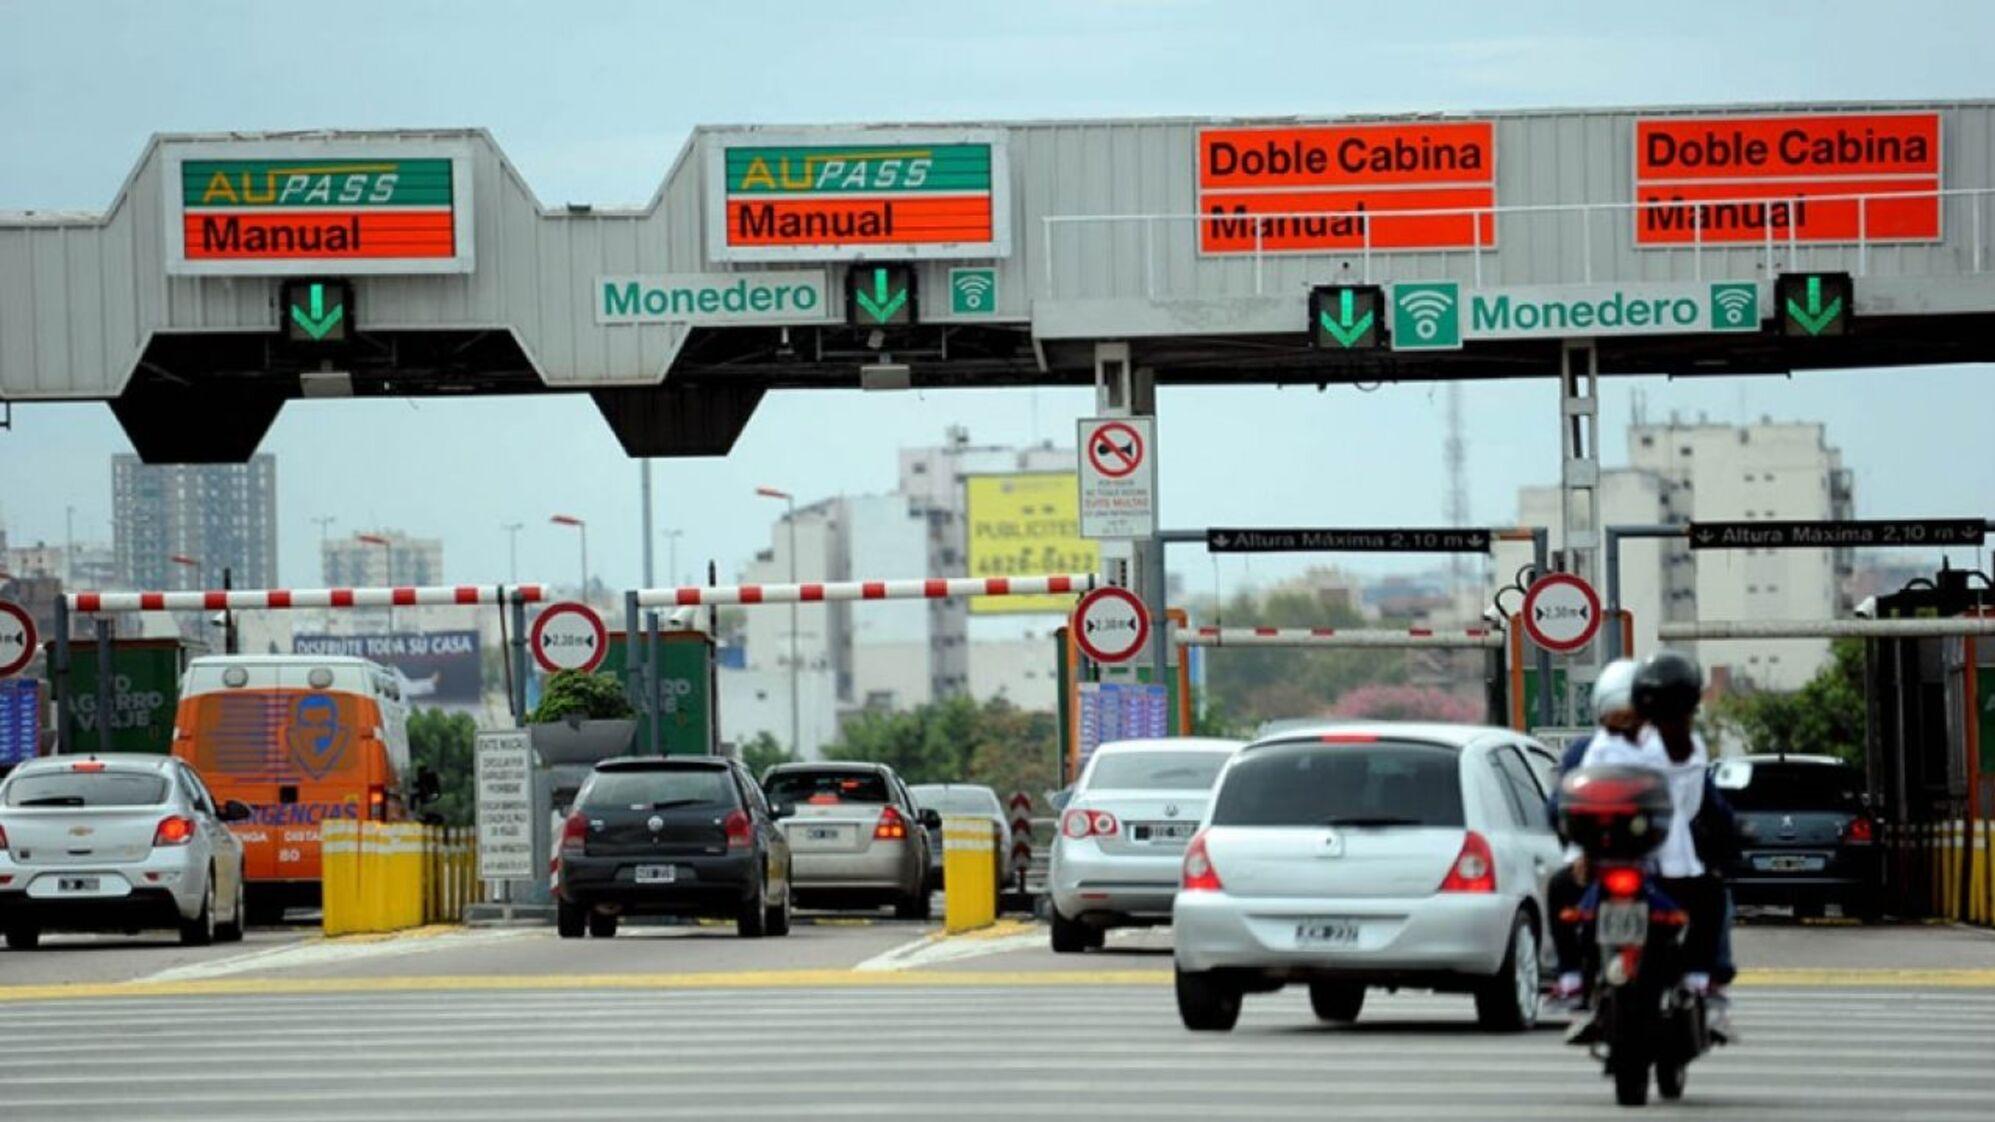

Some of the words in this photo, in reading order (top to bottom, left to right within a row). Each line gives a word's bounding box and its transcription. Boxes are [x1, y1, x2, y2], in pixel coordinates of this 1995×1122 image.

[1209, 140, 1328, 176] Doble
[1337, 136, 1482, 173] Cabina
[1646, 131, 1769, 167] Doble
[1778, 128, 1928, 165] Cabina
[738, 201, 893, 239] Manual
[1209, 202, 1366, 239] Manual
[1646, 194, 1806, 231] Manual
[202, 216, 361, 252] Manual
[603, 279, 818, 316] Monedero
[1471, 291, 1699, 331] Monedero
[1233, 532, 1296, 547] Altura
[1443, 535, 1463, 547] m
[1720, 527, 1784, 544] Altura
[1934, 528, 1955, 540] m
[296, 639, 362, 656] DISFRUTE
[409, 637, 428, 654] SU
[431, 635, 473, 653] CASA
